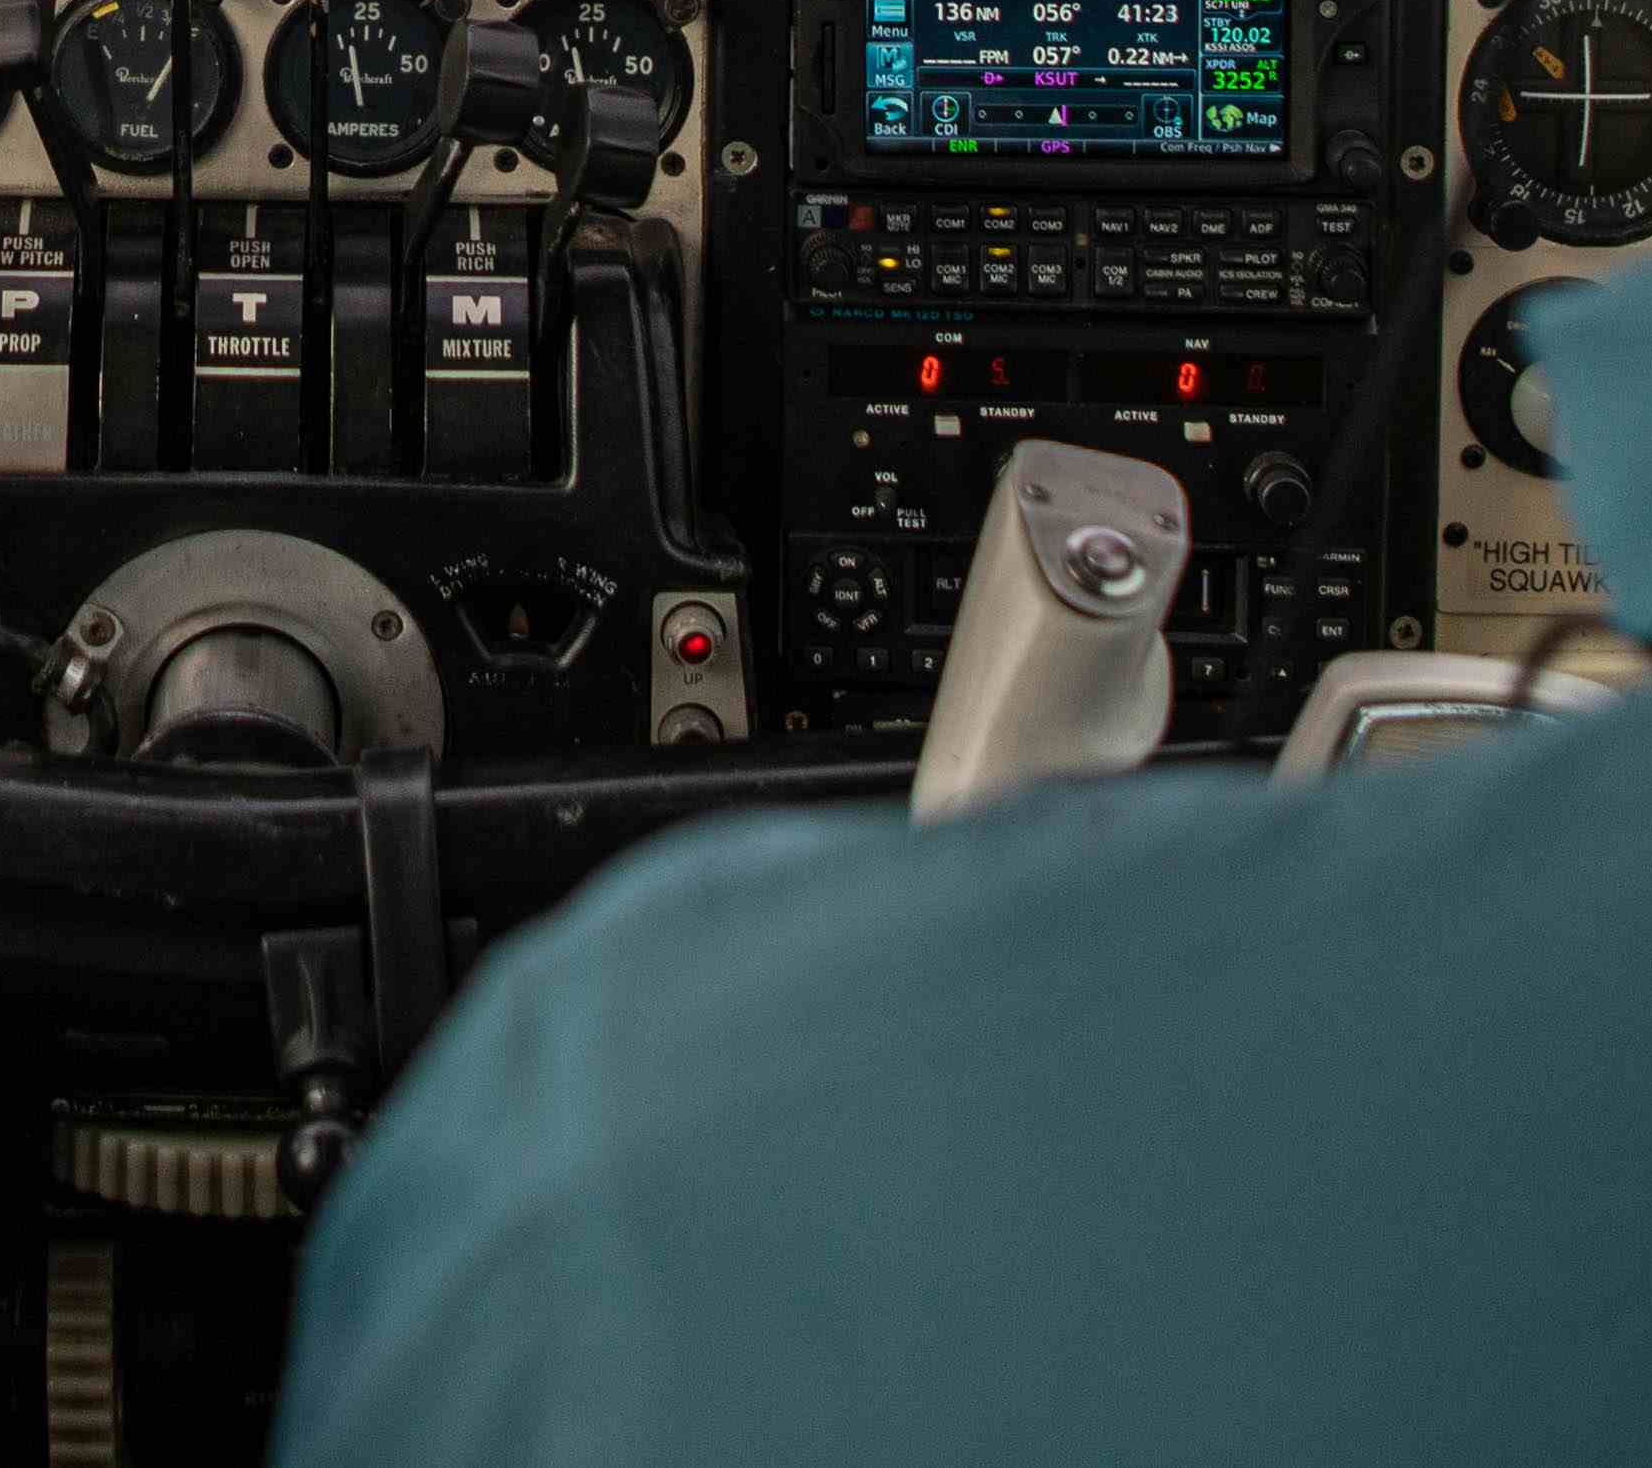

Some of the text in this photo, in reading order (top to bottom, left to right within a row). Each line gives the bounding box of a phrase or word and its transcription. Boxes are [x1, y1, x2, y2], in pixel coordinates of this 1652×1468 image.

[355, 3, 380, 21] 25
[580, 4, 605, 21] 25
[935, 3, 999, 21] 136 NM
[1117, 4, 1178, 22] 41:23
[1204, 18, 1230, 27] STBY
[872, 26, 908, 37] Menu
[1046, 32, 1067, 41] TRK
[1211, 28, 1271, 43] 120.02
[1137, 34, 1158, 42] XTK
[979, 50, 1009, 64] FPM
[400, 56, 428, 73] 50
[625, 57, 653, 74] 50
[1258, 61, 1277, 69] ALT
[875, 74, 905, 85] MSG
[1035, 73, 1079, 85] KSUT
[1247, 113, 1277, 125] Map
[120, 124, 158, 137] FUEL
[874, 123, 906, 135] Back
[935, 124, 958, 135] CDI
[1154, 126, 1182, 137] OBS
[949, 140, 977, 152] ENR
[1041, 141, 1069, 153] GPS
[3, 237, 43, 250] PUSH
[230, 240, 271, 255] PUSH
[455, 242, 496, 256] PUSH
[20, 251, 63, 265] PITCH
[230, 255, 271, 268] OPEN
[457, 256, 495, 271] RICH
[1246, 290, 1278, 298] CREW
[1, 290, 39, 318] P
[233, 293, 267, 322] T
[452, 296, 501, 324] M
[936, 334, 962, 342] COM
[1185, 339, 1209, 349] NAV
[208, 336, 290, 357] THROTTLE
[442, 338, 511, 358] MIXTURE
[866, 405, 908, 414] ACTIVE
[980, 407, 1034, 417] STANDBY
[1115, 411, 1158, 421] ACTIVE
[1229, 414, 1284, 424] STANDBY
[875, 473, 897, 481] VOL
[852, 507, 874, 516] OFF
[898, 518, 926, 528] TEST
[1474, 541, 1548, 564] "HIGH
